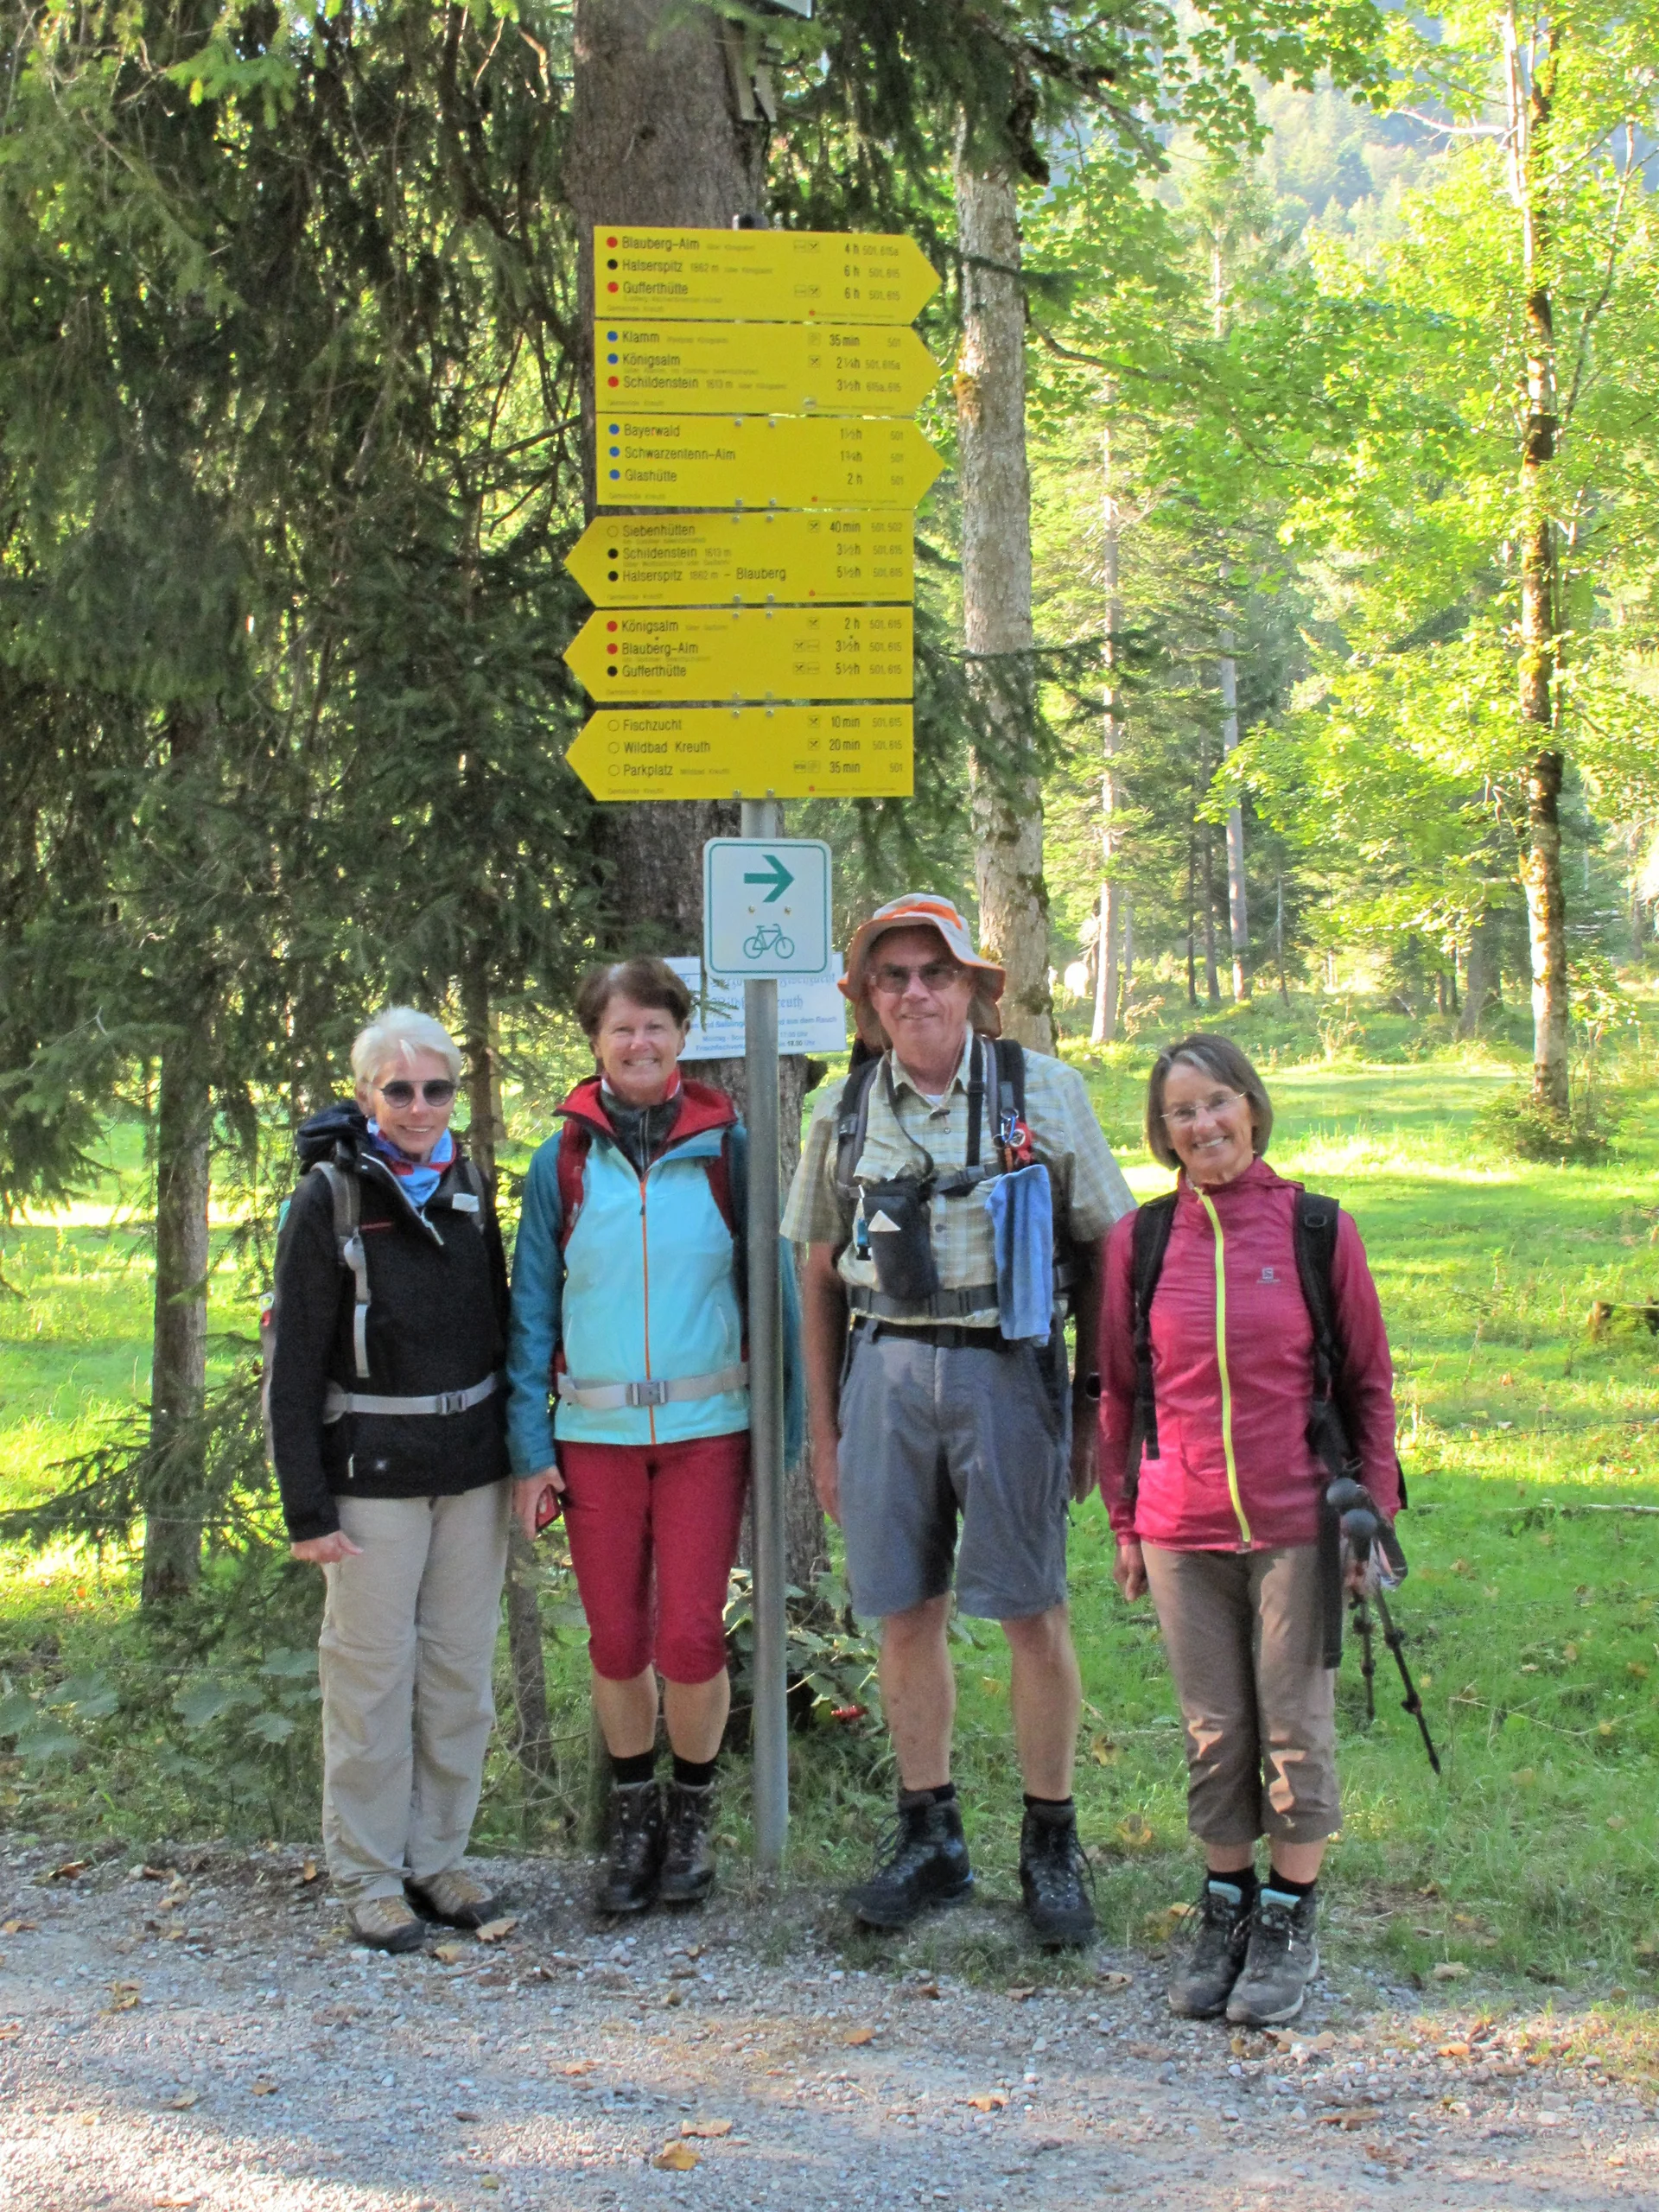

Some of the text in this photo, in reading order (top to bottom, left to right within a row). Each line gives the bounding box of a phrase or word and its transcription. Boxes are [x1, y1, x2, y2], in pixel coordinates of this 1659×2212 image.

[622, 236, 700, 252] Blauberg-Alm
[845, 243, 859, 254] 4 h
[622, 259, 683, 274] Halserspitz
[844, 264, 860, 276] 6 h
[623, 281, 689, 296] Gufferthütte
[844, 287, 860, 299] 6 h
[622, 331, 660, 343] Klamm
[830, 334, 860, 346] 35 min
[623, 353, 681, 368] Königsalm
[623, 375, 699, 389] Schildenstein
[624, 423, 680, 439] Bayerwald
[625, 468, 677, 482] Glashütte
[847, 473, 862, 485] 2 h
[622, 524, 696, 537] Siebenhütten
[830, 520, 861, 533] 40 min
[623, 546, 697, 560] Schildenstein
[623, 569, 683, 584] Halserspitz
[736, 567, 786, 582] Blauberg
[621, 619, 678, 634] Königsalm
[844, 617, 860, 630] 2 h
[621, 642, 698, 658] Blauberg-Alm
[622, 664, 687, 677] Gufferthütte
[623, 719, 682, 732] Fischzucht
[831, 715, 861, 728] 10 min
[624, 740, 710, 754] Wildbad Kreuth
[829, 739, 861, 751] 20 min
[623, 764, 673, 779] Parkplatz
[829, 761, 861, 773] 35 min
[778, 995, 804, 1010] reuth
